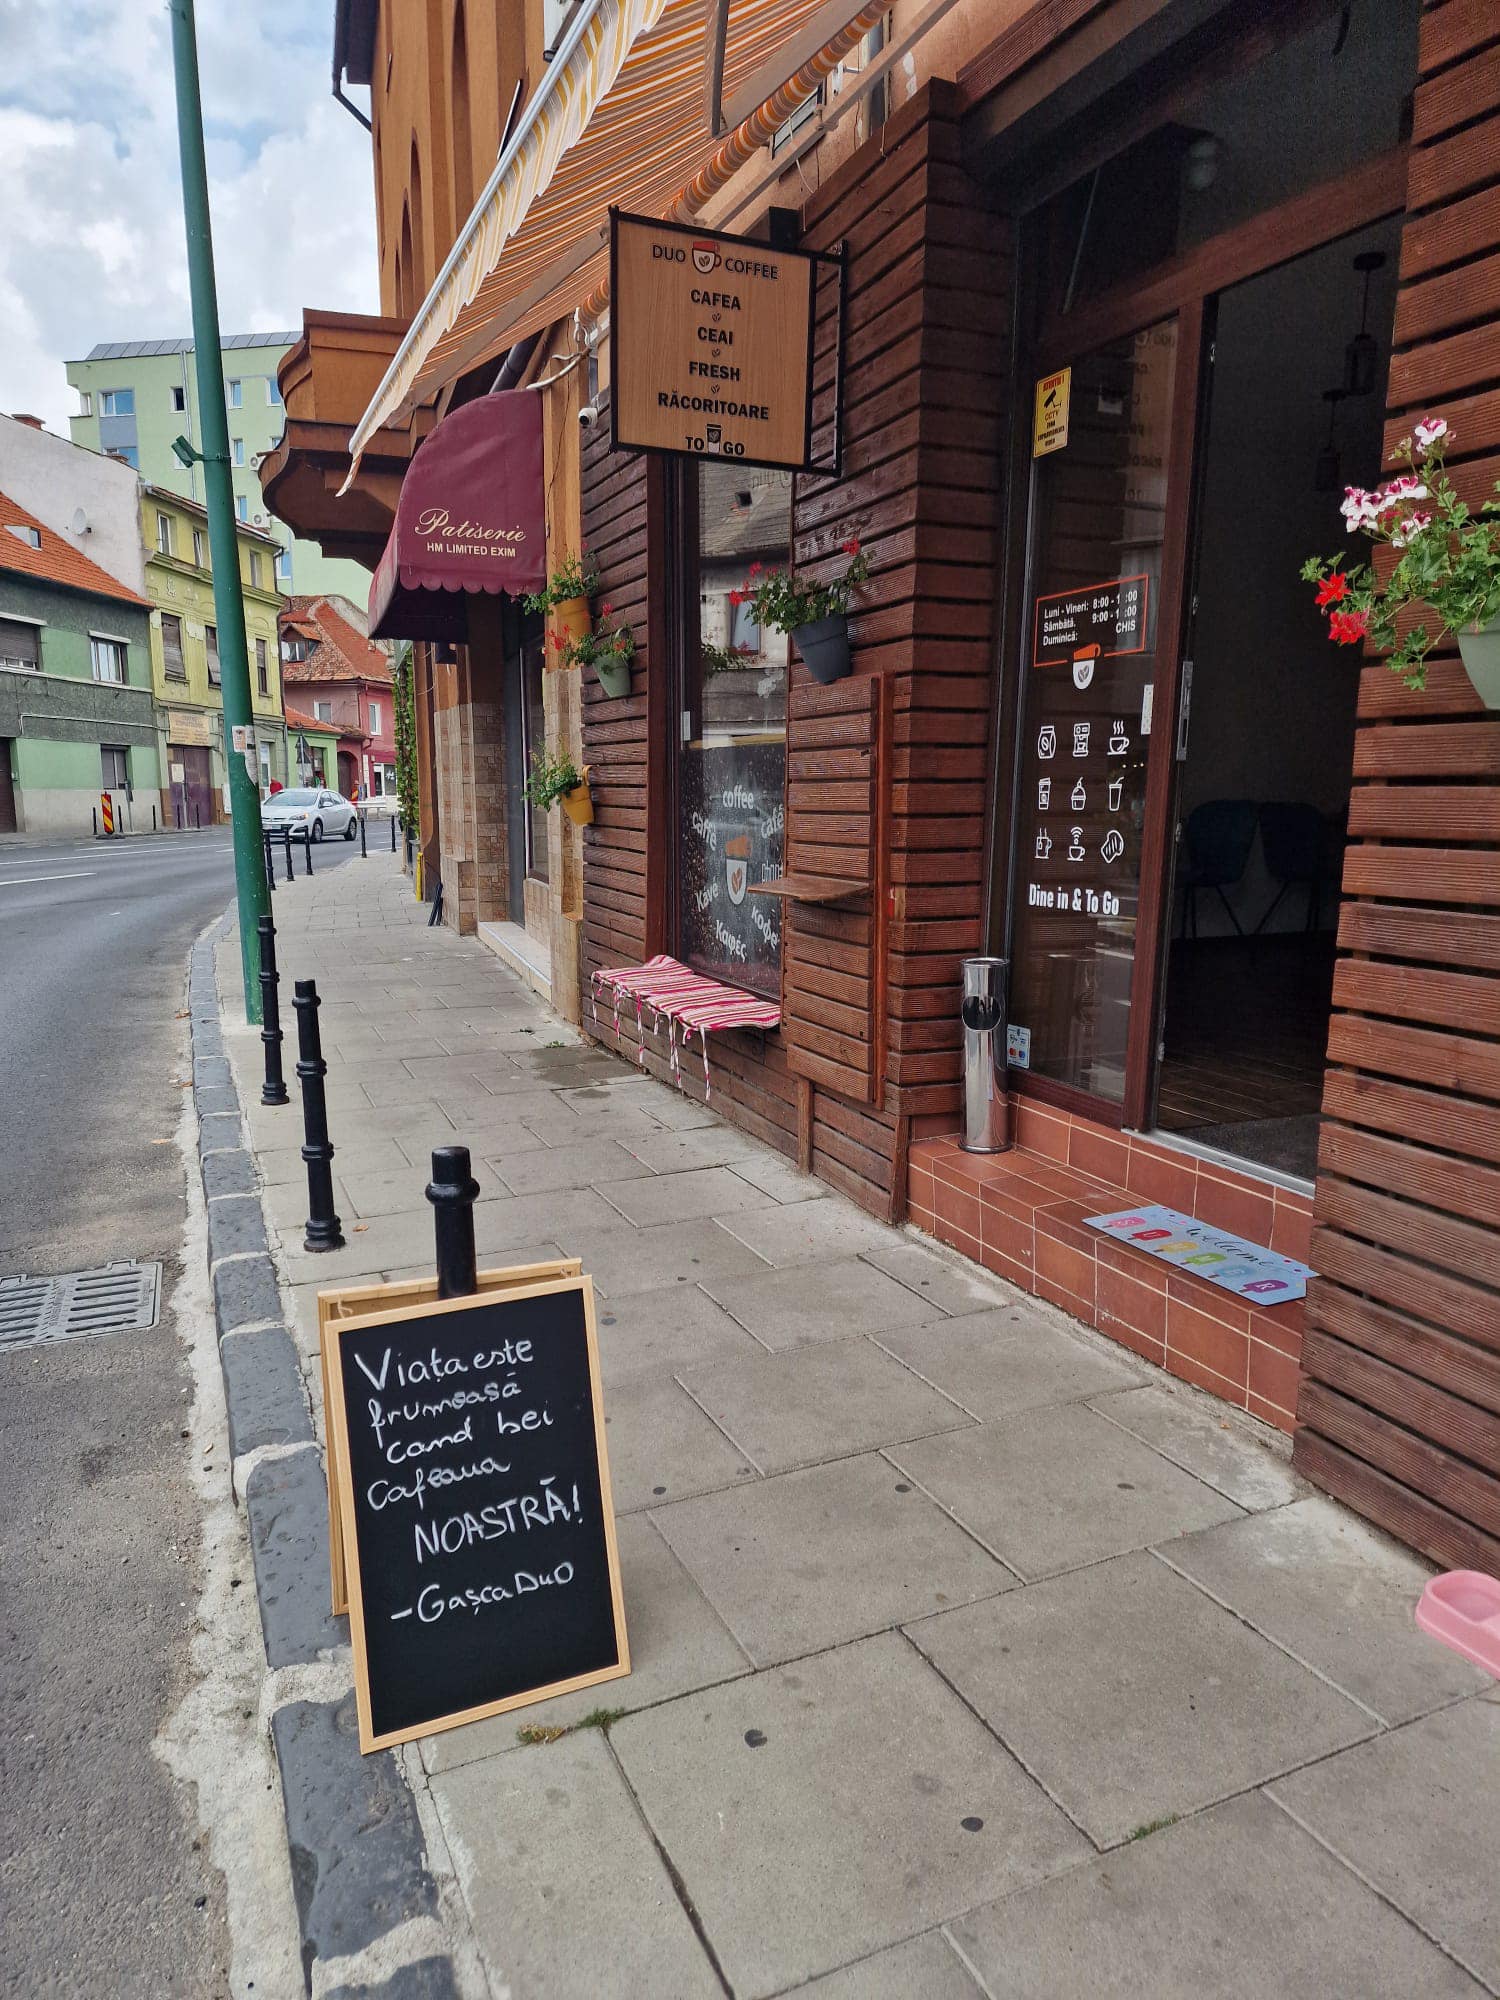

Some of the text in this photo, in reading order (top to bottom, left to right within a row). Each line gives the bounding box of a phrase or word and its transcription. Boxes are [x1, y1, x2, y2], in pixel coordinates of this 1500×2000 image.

[653, 244, 779, 280] DUO COFFEE
[690, 288, 741, 311] CAFEA
[697, 326, 733, 345] CEAI
[689, 361, 740, 381] FRESH
[658, 390, 769, 420] RĂCORITOARE
[685, 436, 745, 456] TO GO
[414, 508, 527, 542] Patiserie
[427, 542, 516, 558] HM LIMITED EXIM
[1044, 605, 1060, 619] Luni
[1092, 595, 1109, 610] 8:00
[1092, 610, 1109, 624] 9:00
[722, 784, 754, 809] coffee
[1029, 883, 1120, 915] Dine in & To Go
[473, 1338, 534, 1370] este
[497, 1399, 554, 1435] bei
